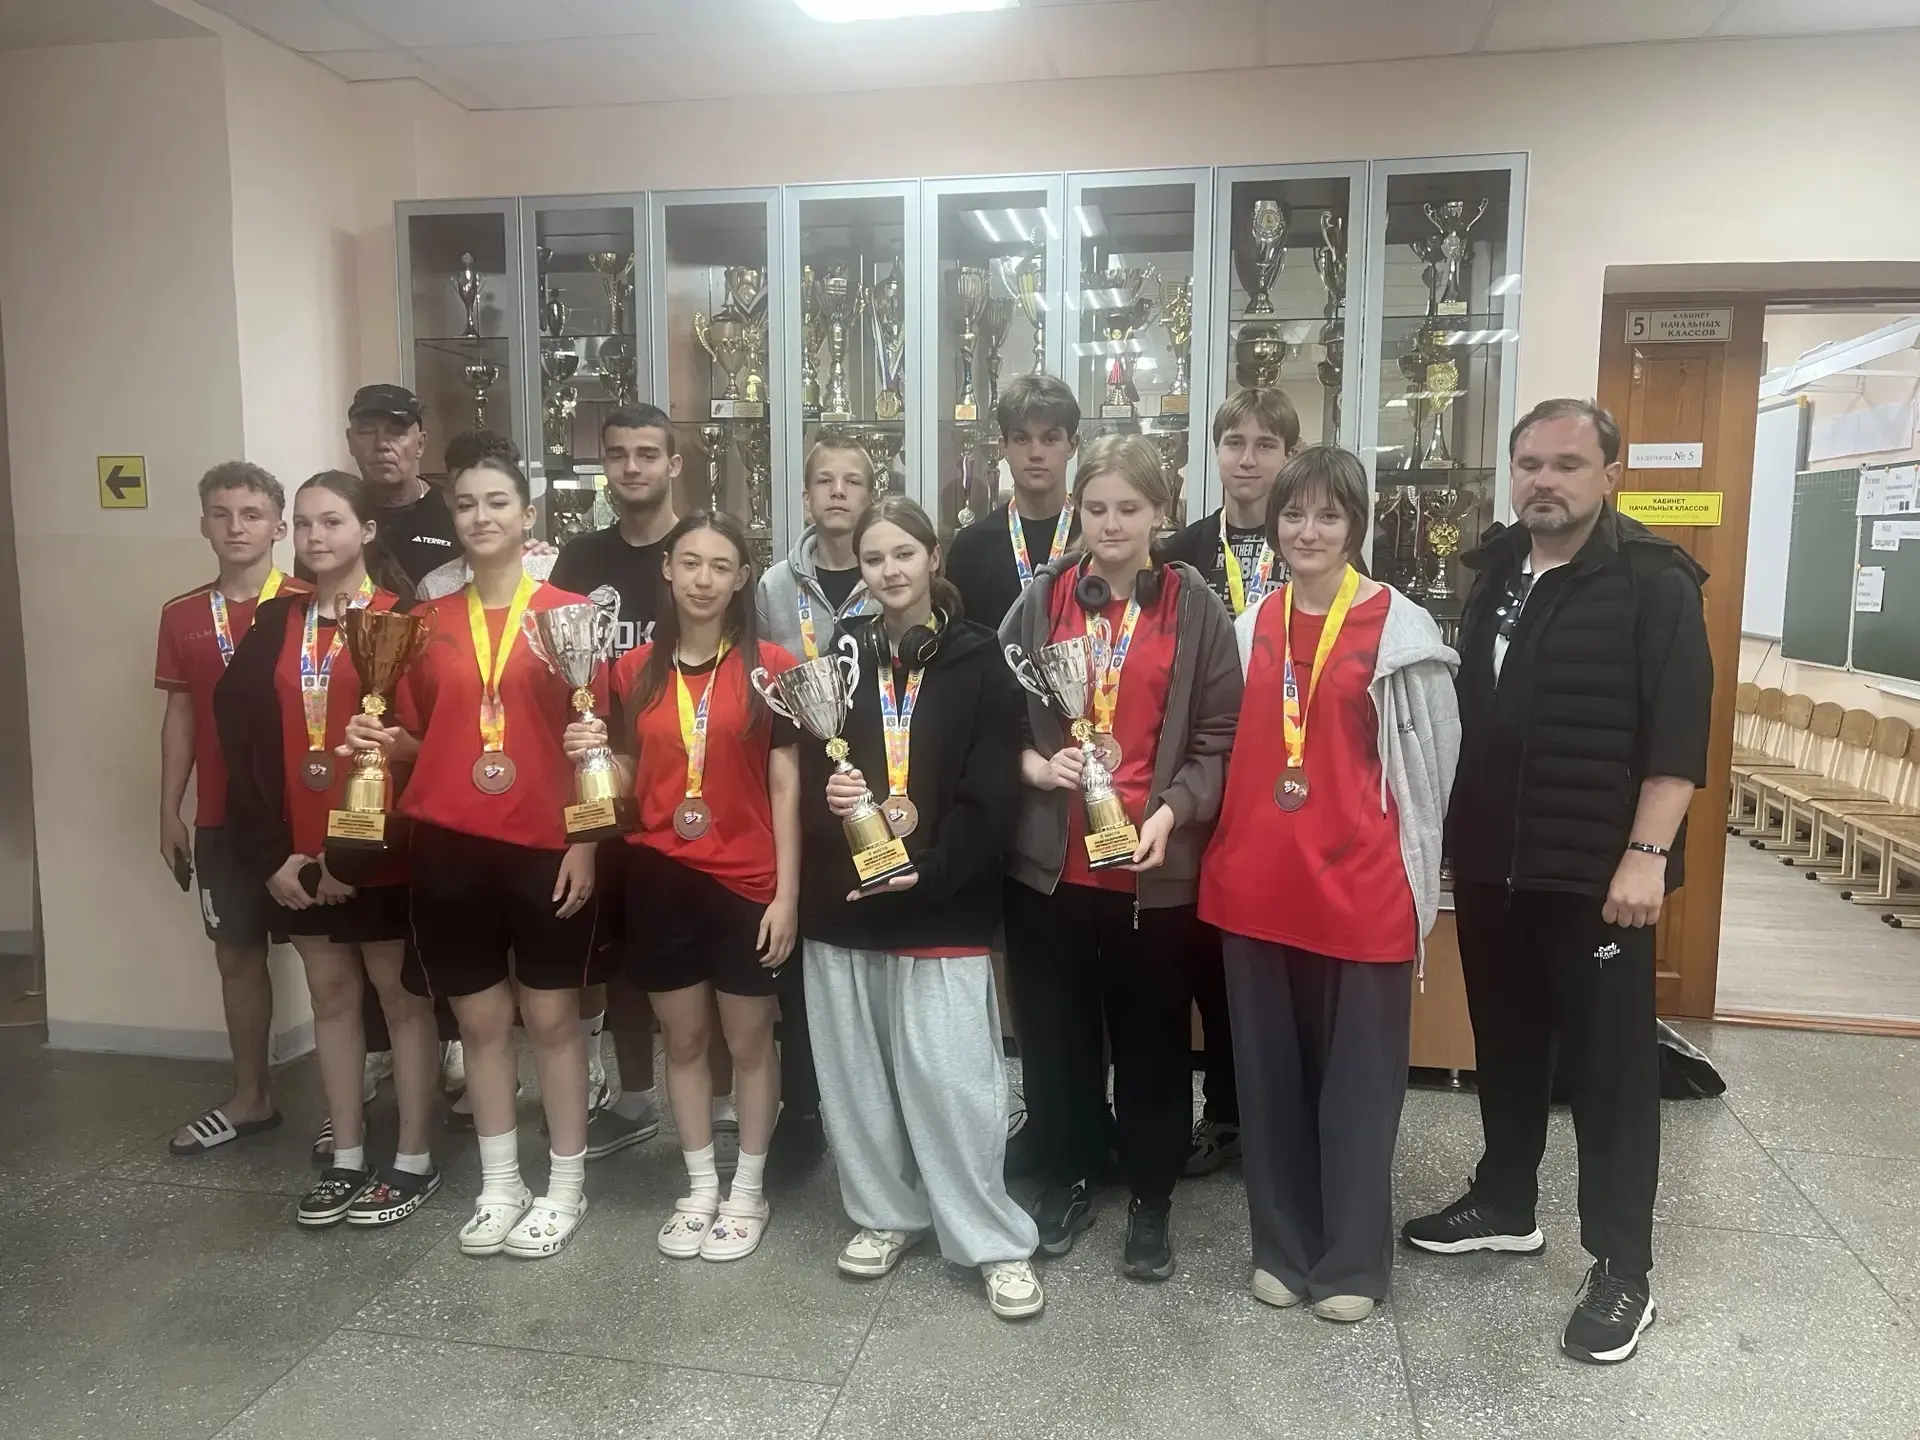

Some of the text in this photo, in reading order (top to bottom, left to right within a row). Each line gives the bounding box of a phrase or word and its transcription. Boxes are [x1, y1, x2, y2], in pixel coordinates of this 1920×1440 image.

[1633, 316, 1645, 336] 5
[1660, 320, 1720, 329] НАЧАЛЬНЫХ
[1668, 329, 1716, 337] КЛАССОВ
[1688, 450, 1694, 460] 5
[422, 536, 452, 548] TERREX
[378, 1200, 416, 1221] crocs
